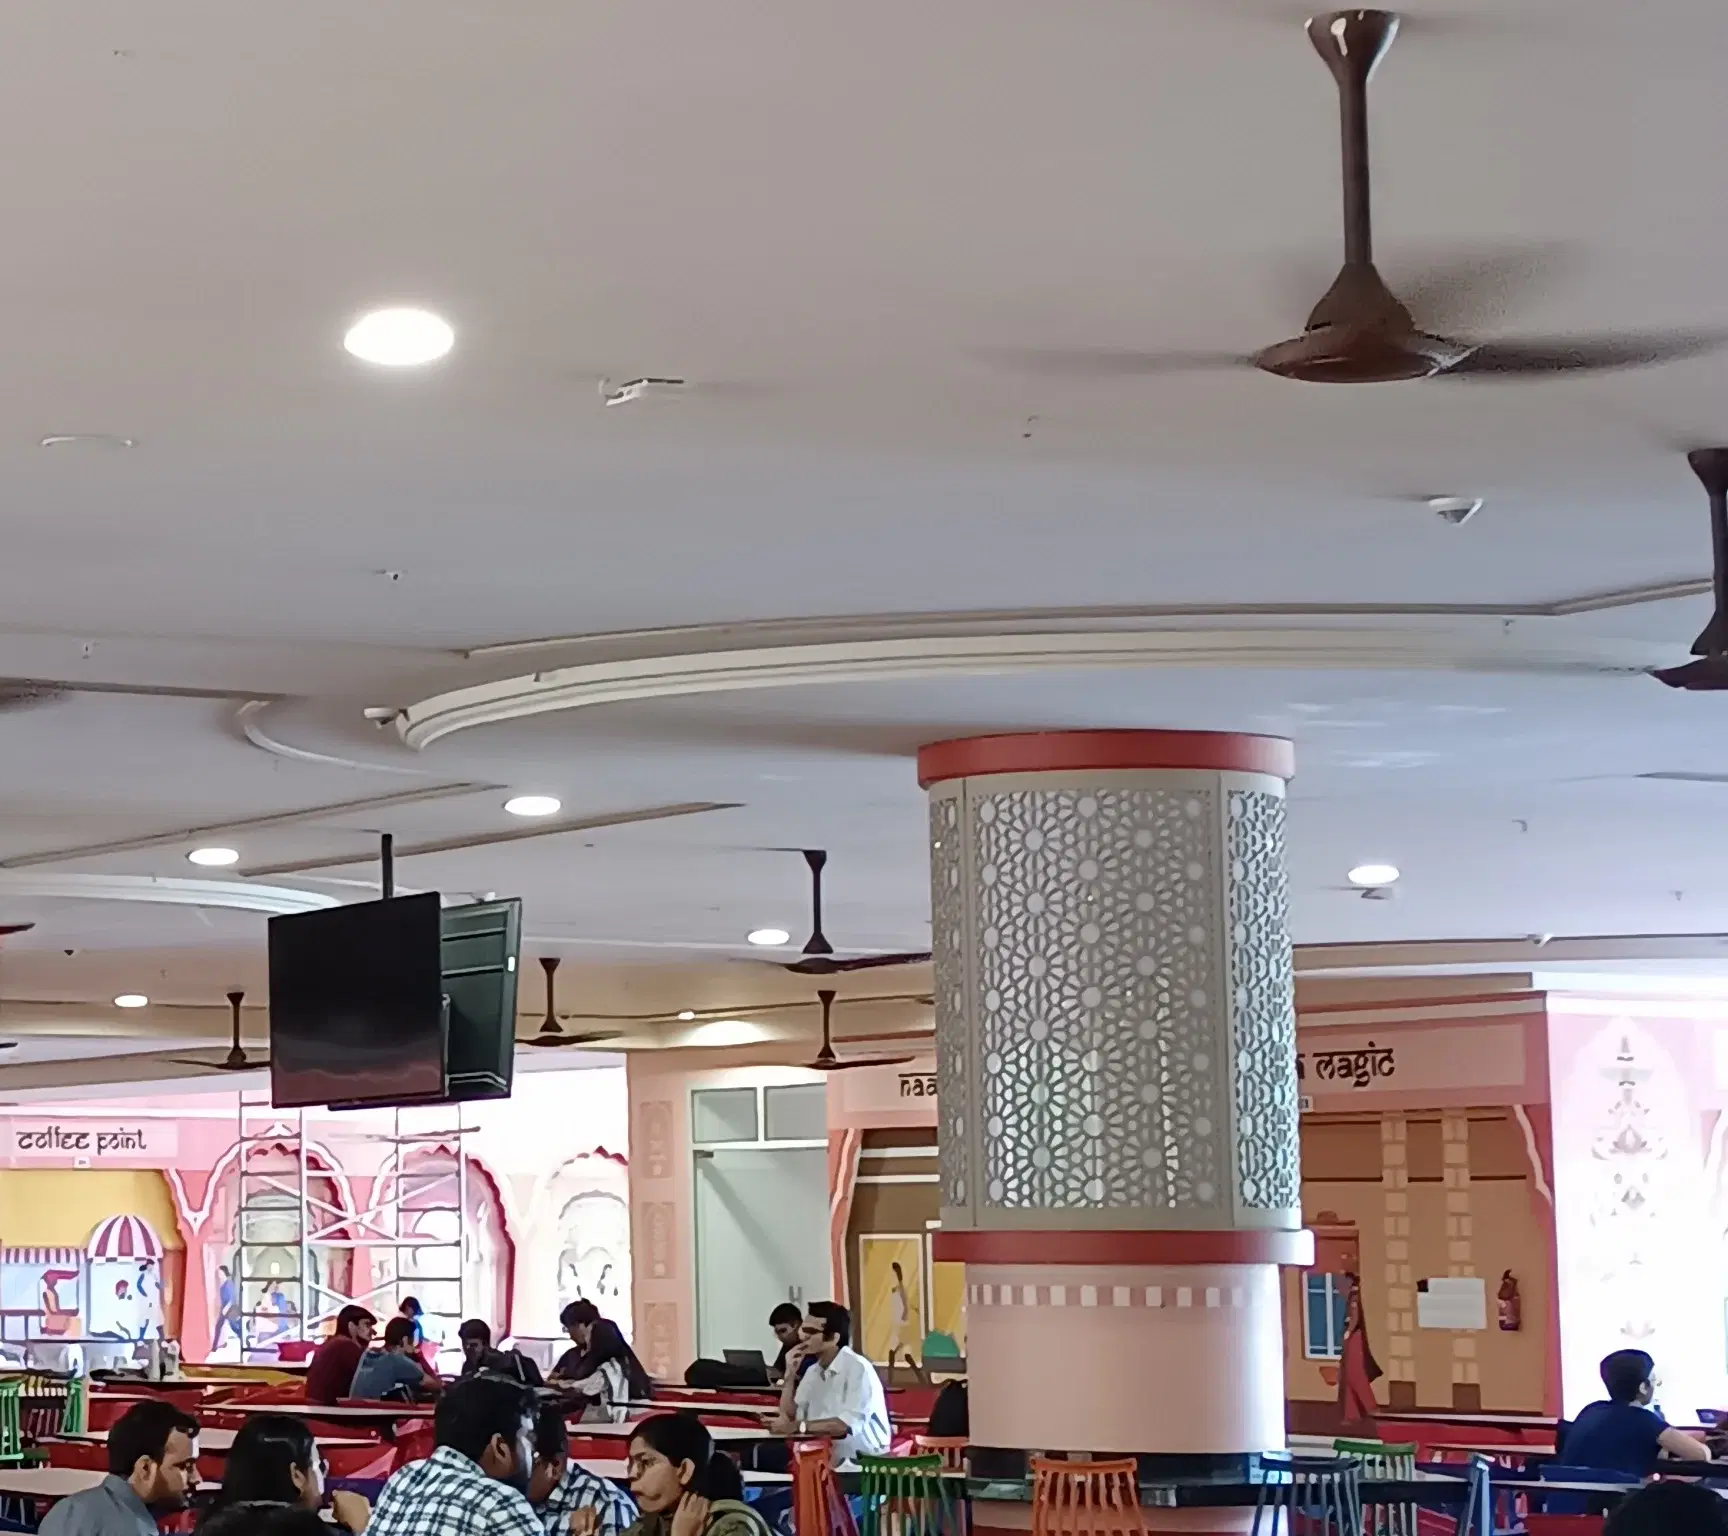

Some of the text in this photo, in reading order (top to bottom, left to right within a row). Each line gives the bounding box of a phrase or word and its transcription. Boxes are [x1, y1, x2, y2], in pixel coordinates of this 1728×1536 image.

[1312, 1040, 1395, 1088] magic
[898, 1072, 938, 1097] naa
[15, 1125, 147, 1156] coffee point
